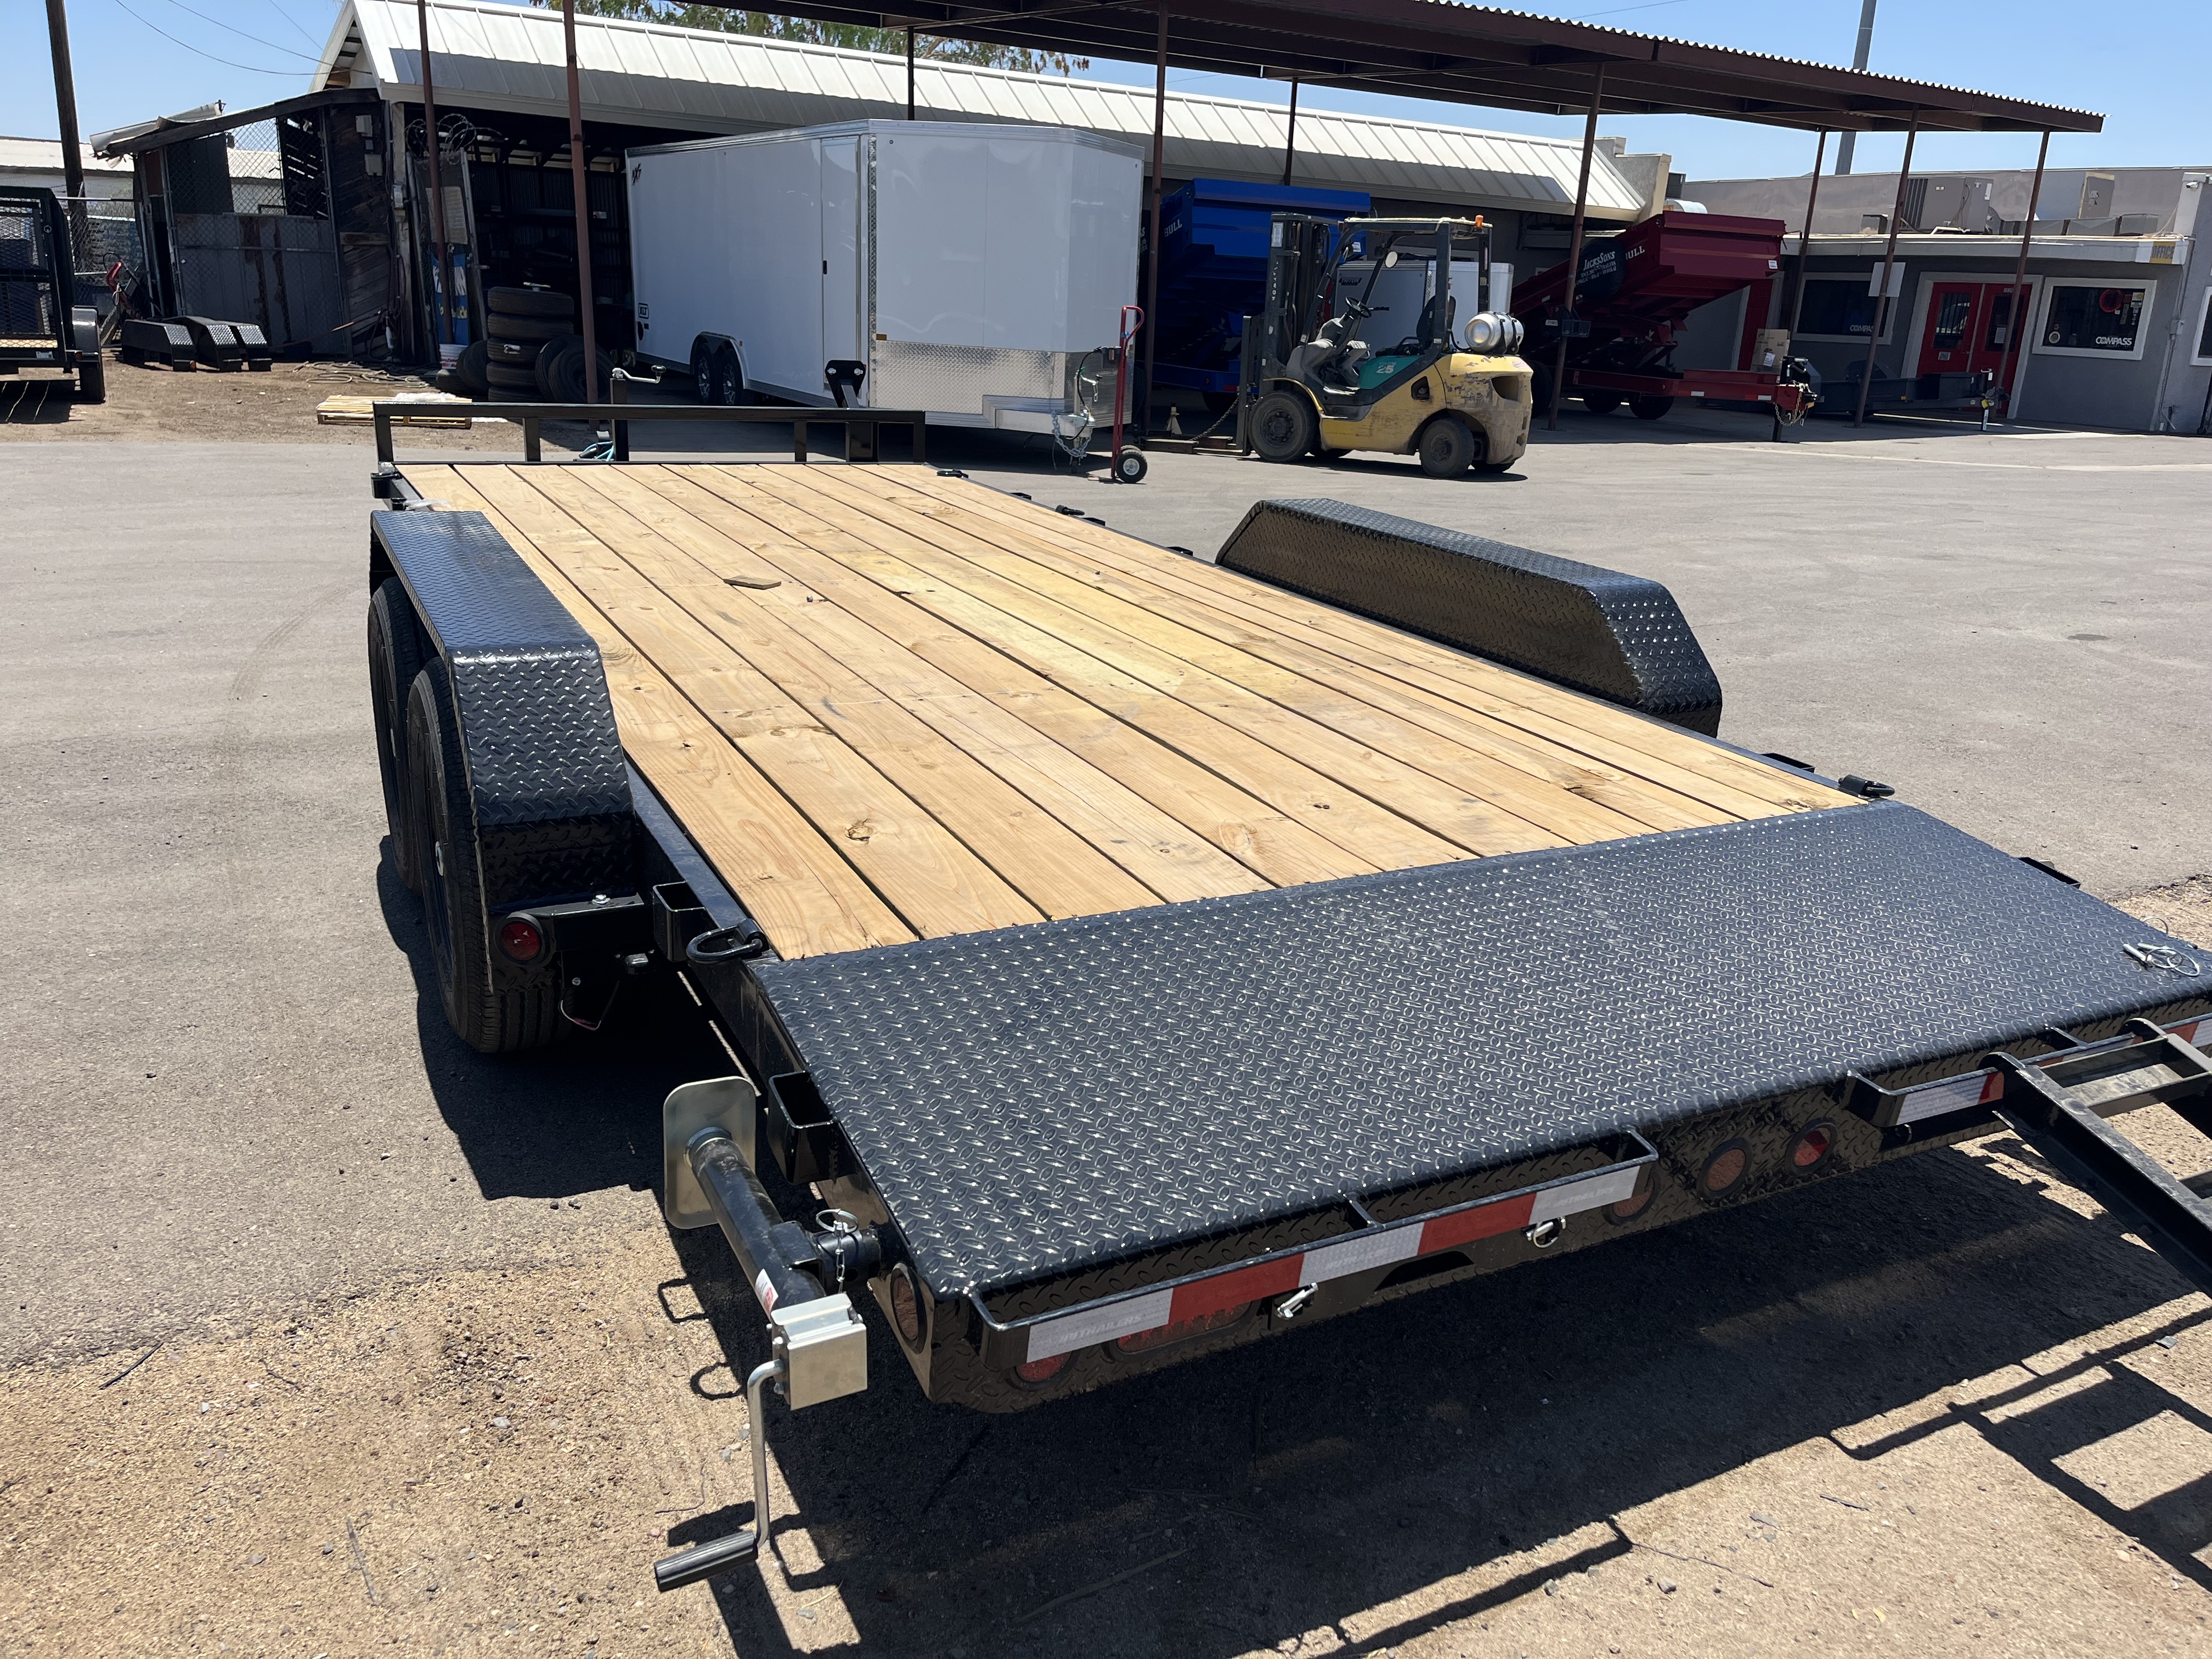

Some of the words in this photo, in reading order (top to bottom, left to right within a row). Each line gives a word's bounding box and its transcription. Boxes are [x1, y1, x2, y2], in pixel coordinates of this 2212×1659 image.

[1164, 219, 1182, 238] BULL
[2151, 245, 2175, 259] OFFICE
[2095, 336, 2132, 346] COMPASS
[1376, 365, 1394, 374] 25
